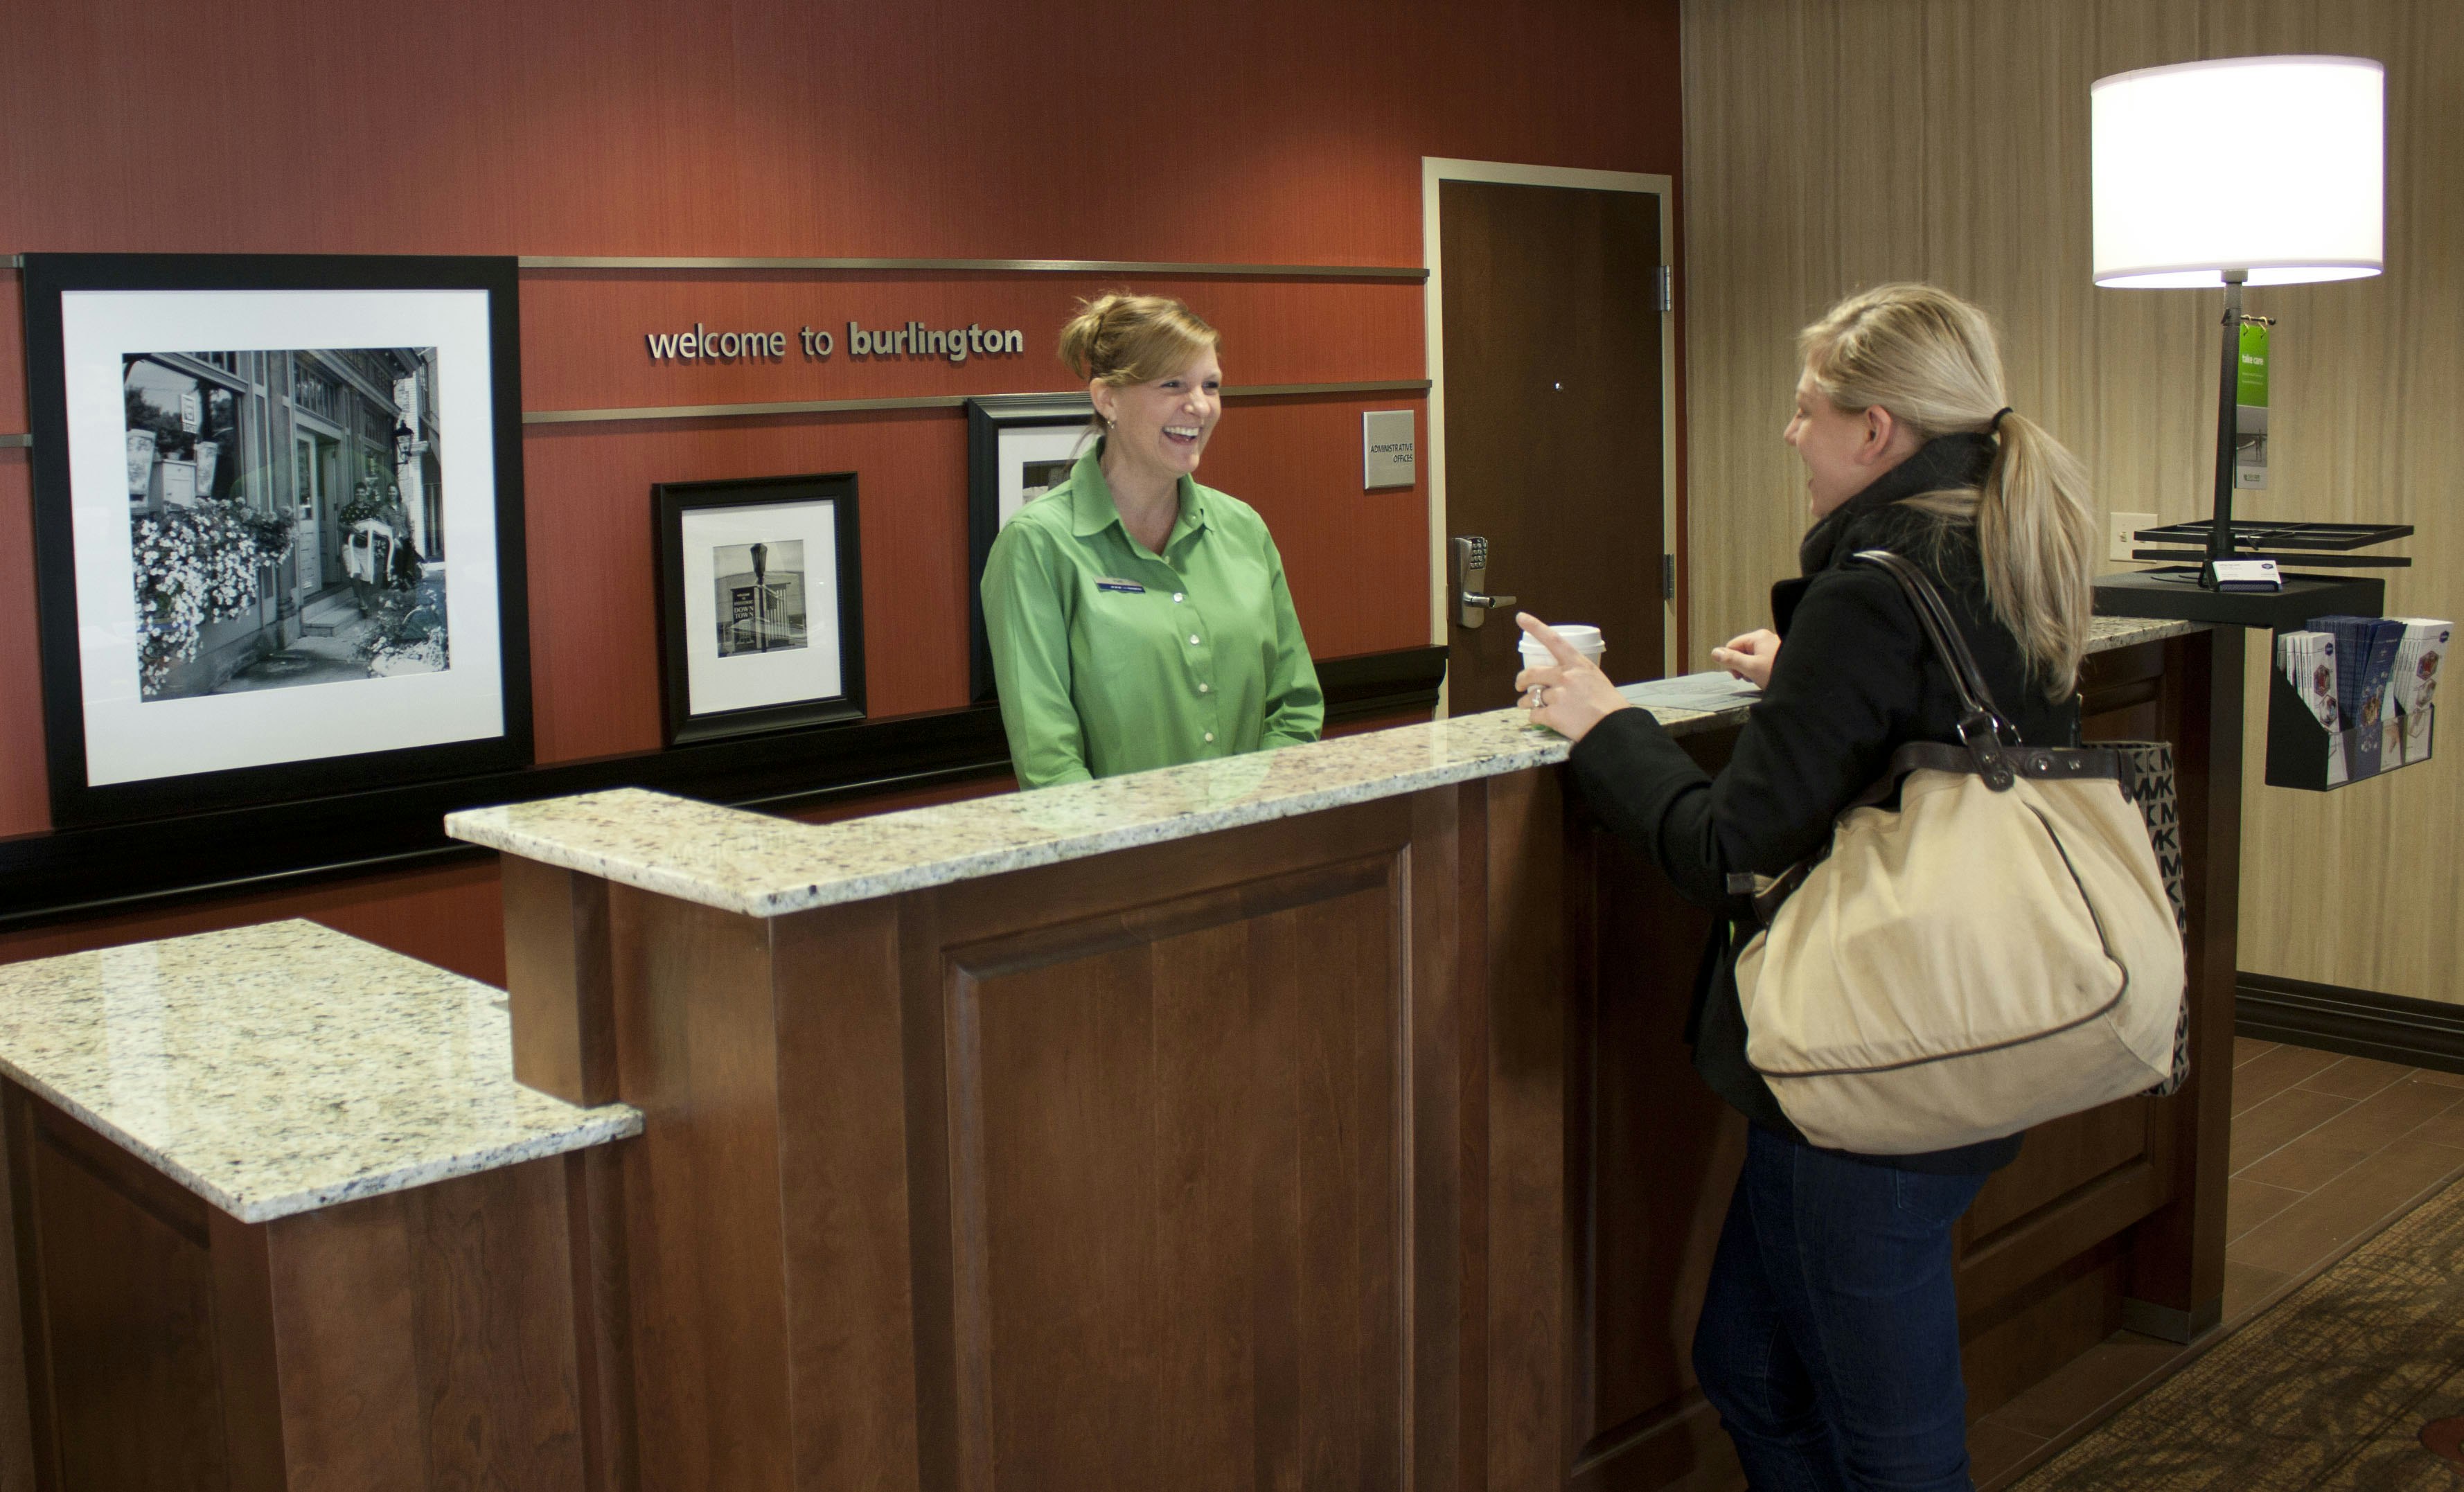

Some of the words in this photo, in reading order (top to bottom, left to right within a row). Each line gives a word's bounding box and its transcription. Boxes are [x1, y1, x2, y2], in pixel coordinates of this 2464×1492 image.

[647, 323, 786, 359] welcome
[800, 326, 833, 355] to
[849, 321, 1024, 362] burlington
[1370, 443, 1413, 453] ADMINISTRATIVE
[1393, 454, 1413, 463] OFFICES
